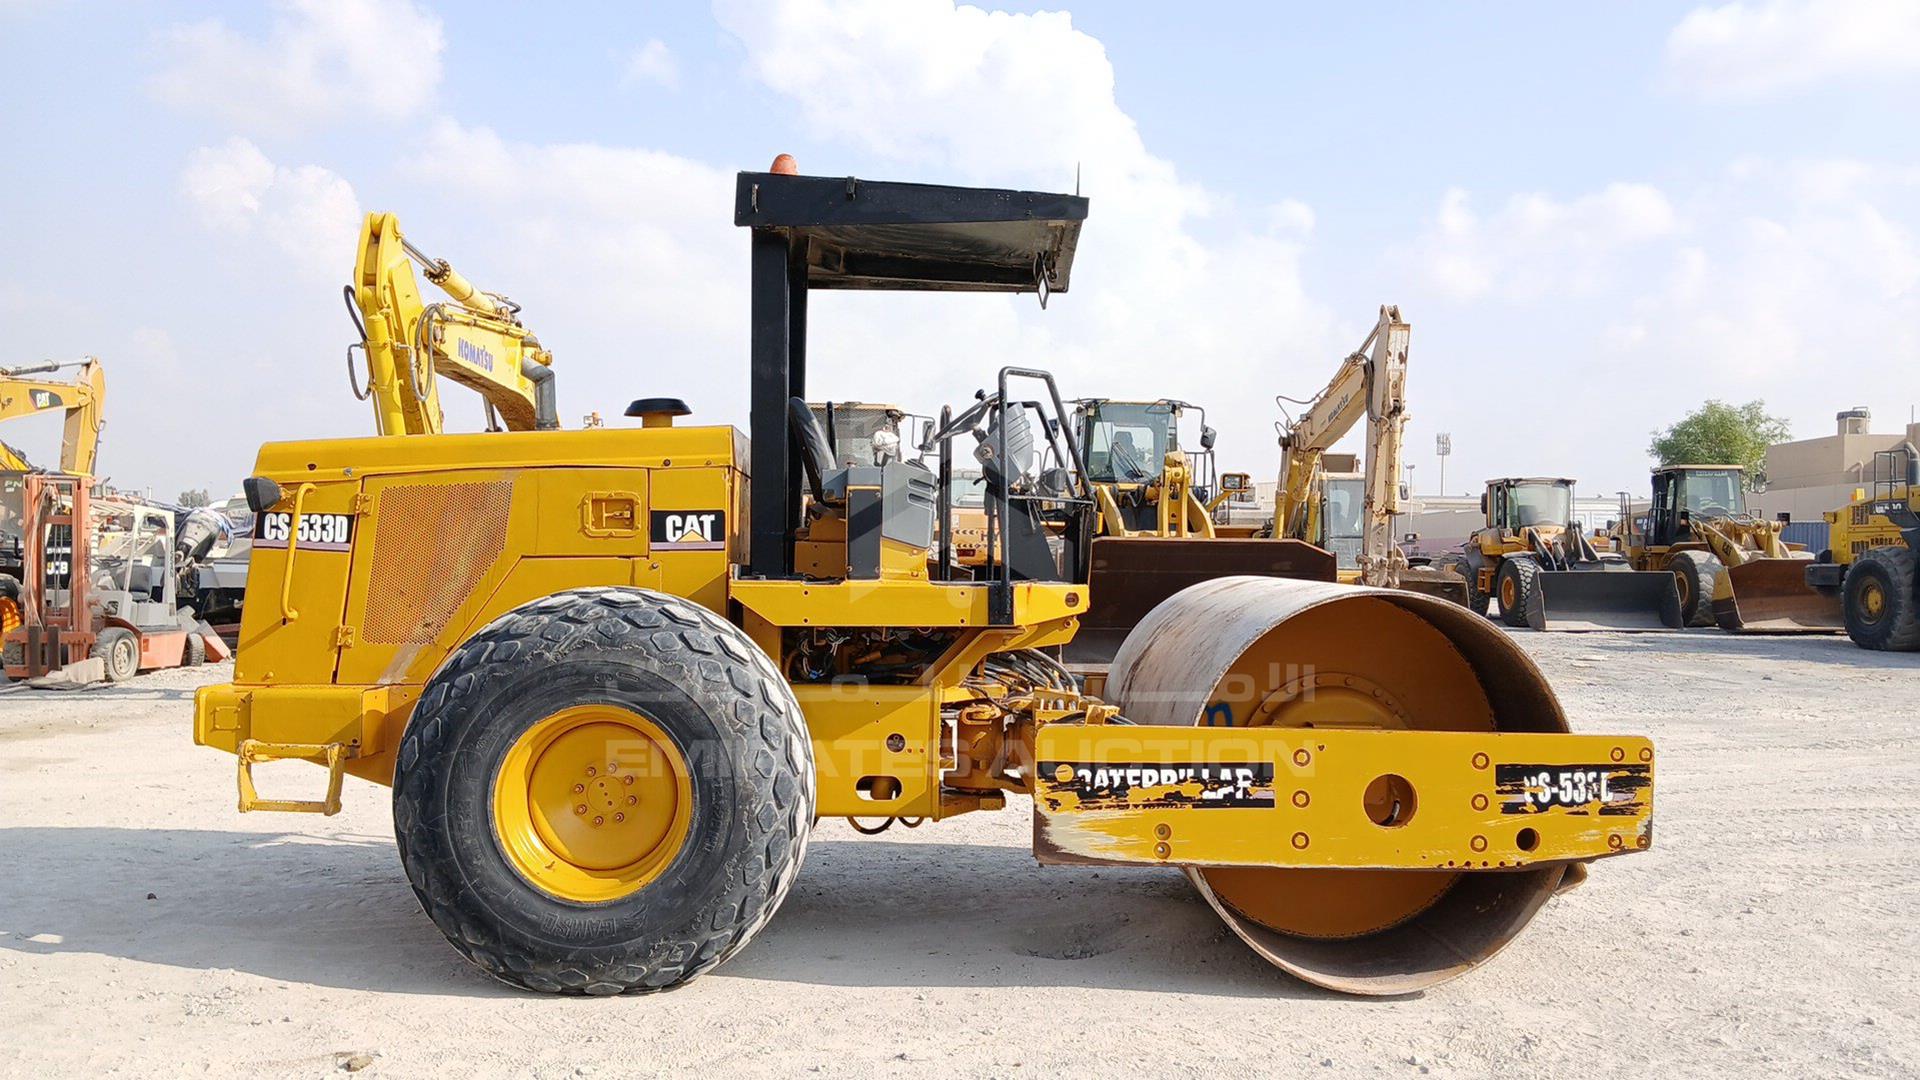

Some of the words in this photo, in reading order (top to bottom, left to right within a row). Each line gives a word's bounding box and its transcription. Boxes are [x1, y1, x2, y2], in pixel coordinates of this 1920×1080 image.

[457, 336, 494, 373] KOMATSU
[36, 392, 50, 408] CAT
[264, 513, 348, 543] CS533D
[664, 514, 716, 543] CAT
